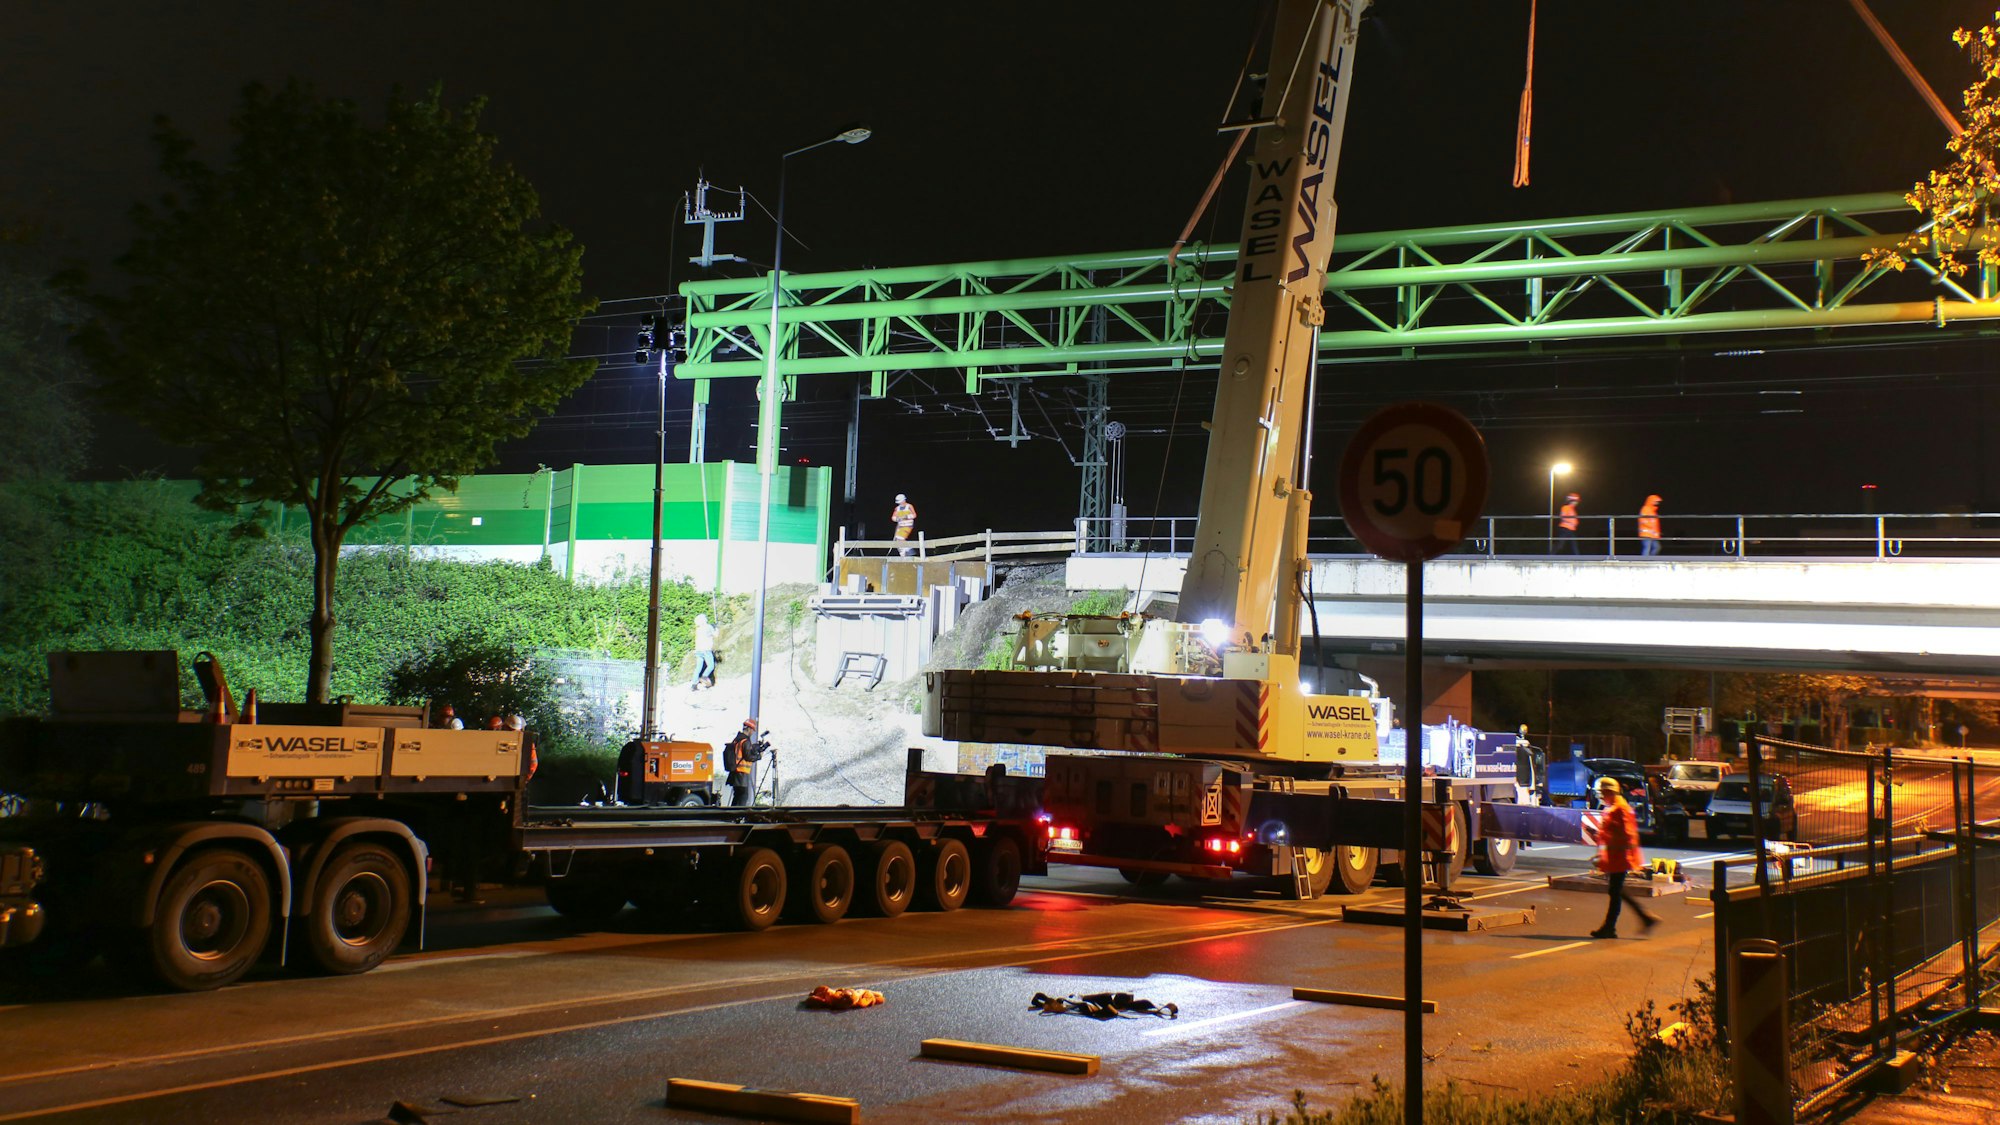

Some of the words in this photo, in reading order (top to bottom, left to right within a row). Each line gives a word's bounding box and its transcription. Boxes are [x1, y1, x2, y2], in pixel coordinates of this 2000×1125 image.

[1287, 46, 1343, 284] WASEL
[1242, 157, 1294, 283] WASEL
[1373, 446, 1452, 517] 50
[1307, 729, 1371, 740] www.wasel-krane.de
[1308, 704, 1371, 721] WASEL
[265, 736, 353, 752] WASEL
